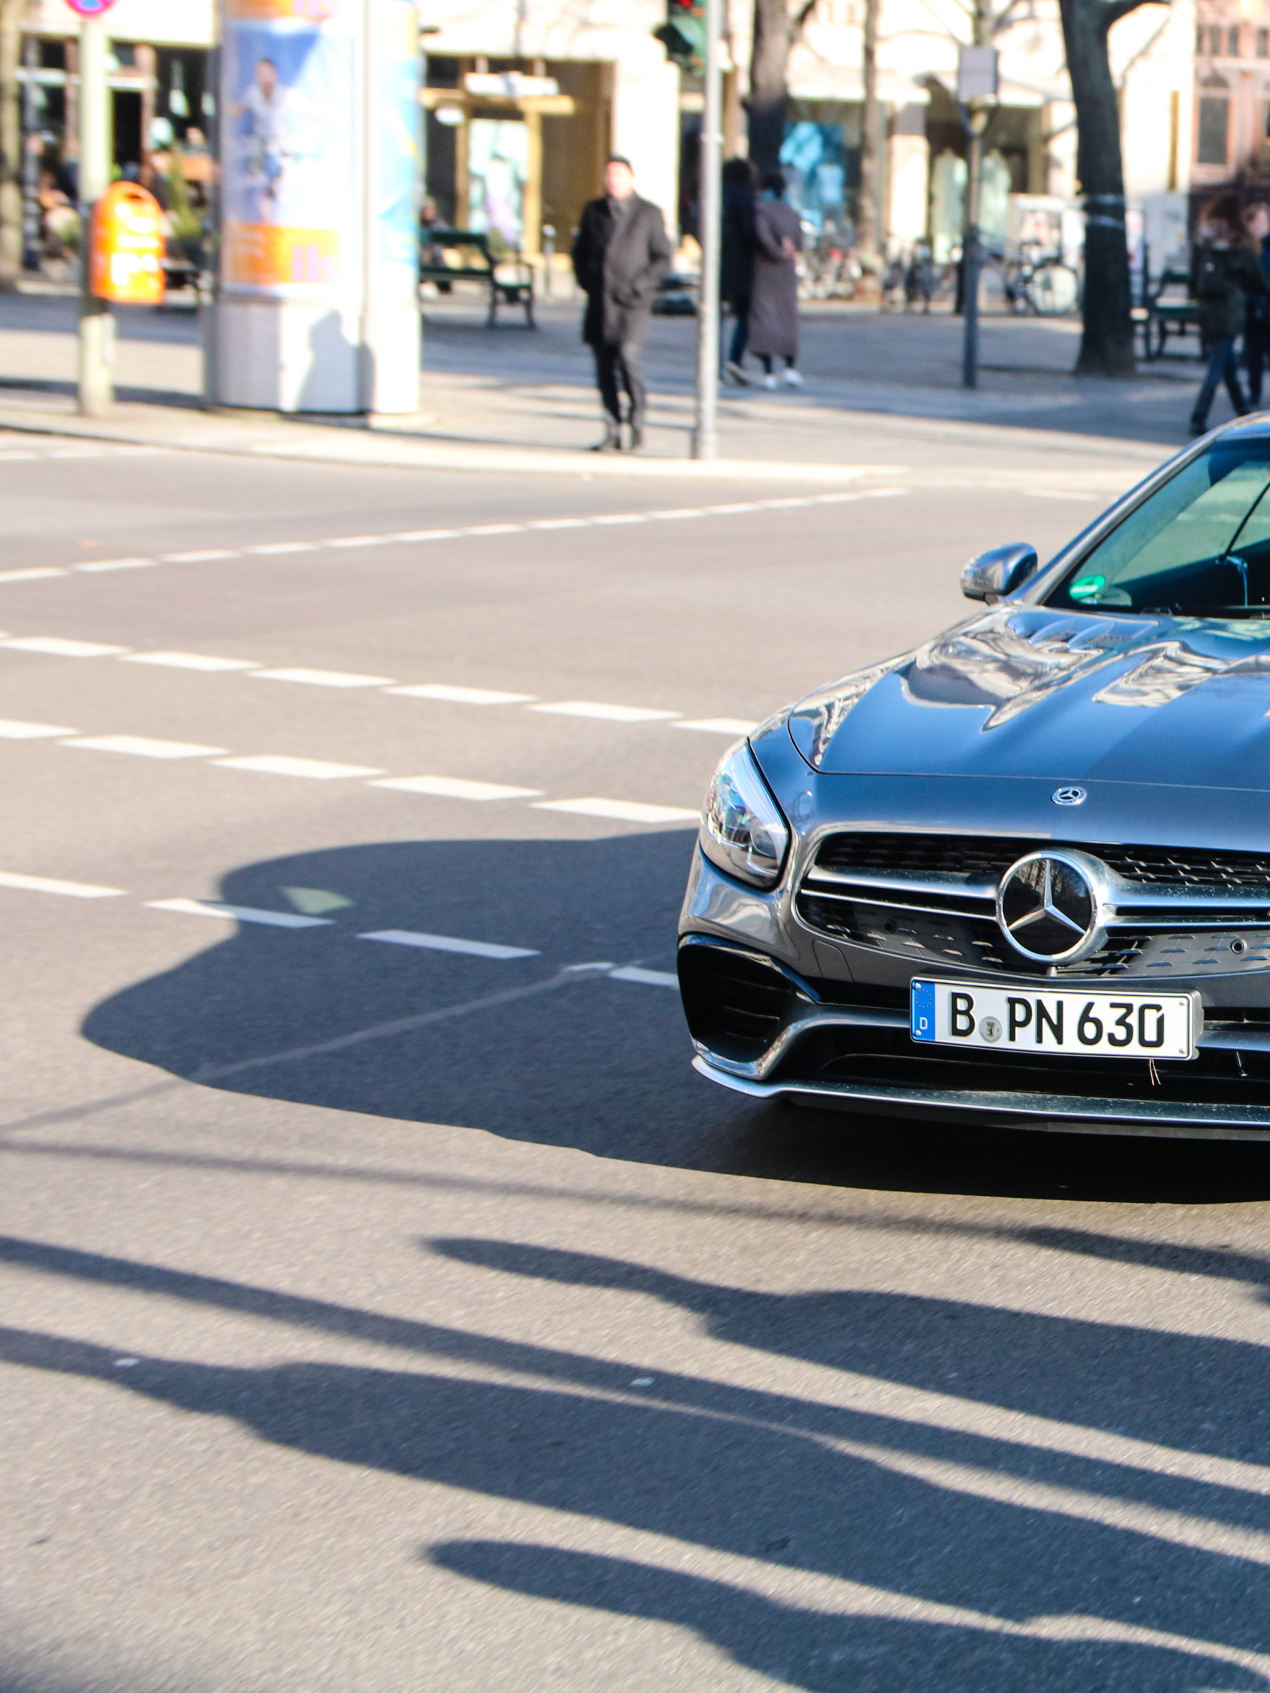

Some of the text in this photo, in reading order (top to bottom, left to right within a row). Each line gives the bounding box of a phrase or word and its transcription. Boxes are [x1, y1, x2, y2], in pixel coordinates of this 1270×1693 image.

[919, 1017, 928, 1030] D
[950, 991, 1165, 1048] B PN 630
